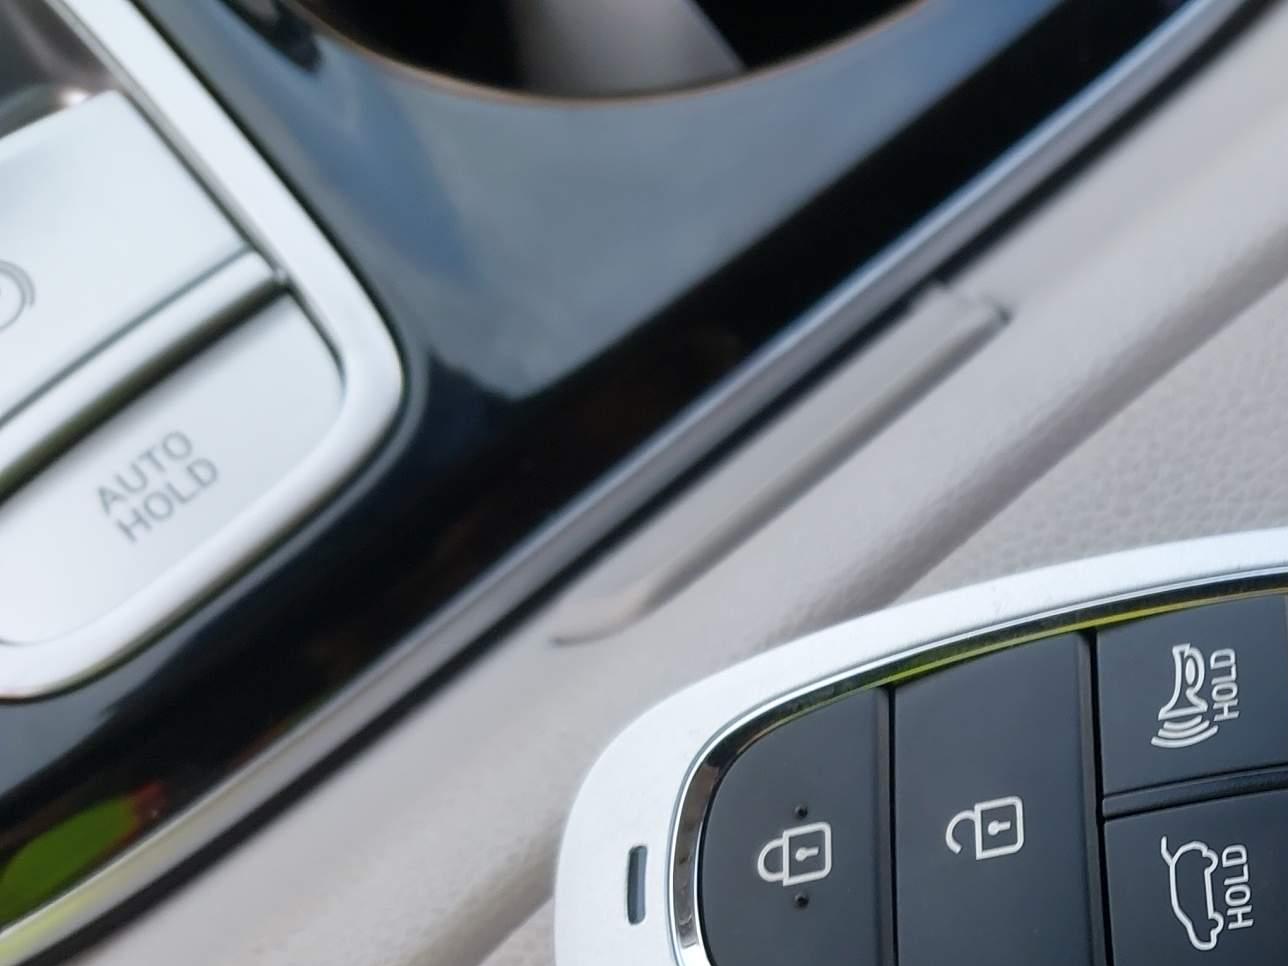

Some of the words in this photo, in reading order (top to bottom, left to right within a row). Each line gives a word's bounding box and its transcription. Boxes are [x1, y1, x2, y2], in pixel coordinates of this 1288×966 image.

[98, 431, 192, 515] AUTO
[115, 457, 218, 542] HOLD
[1210, 648, 1239, 722] HOLD
[1222, 845, 1254, 930] HOLD
